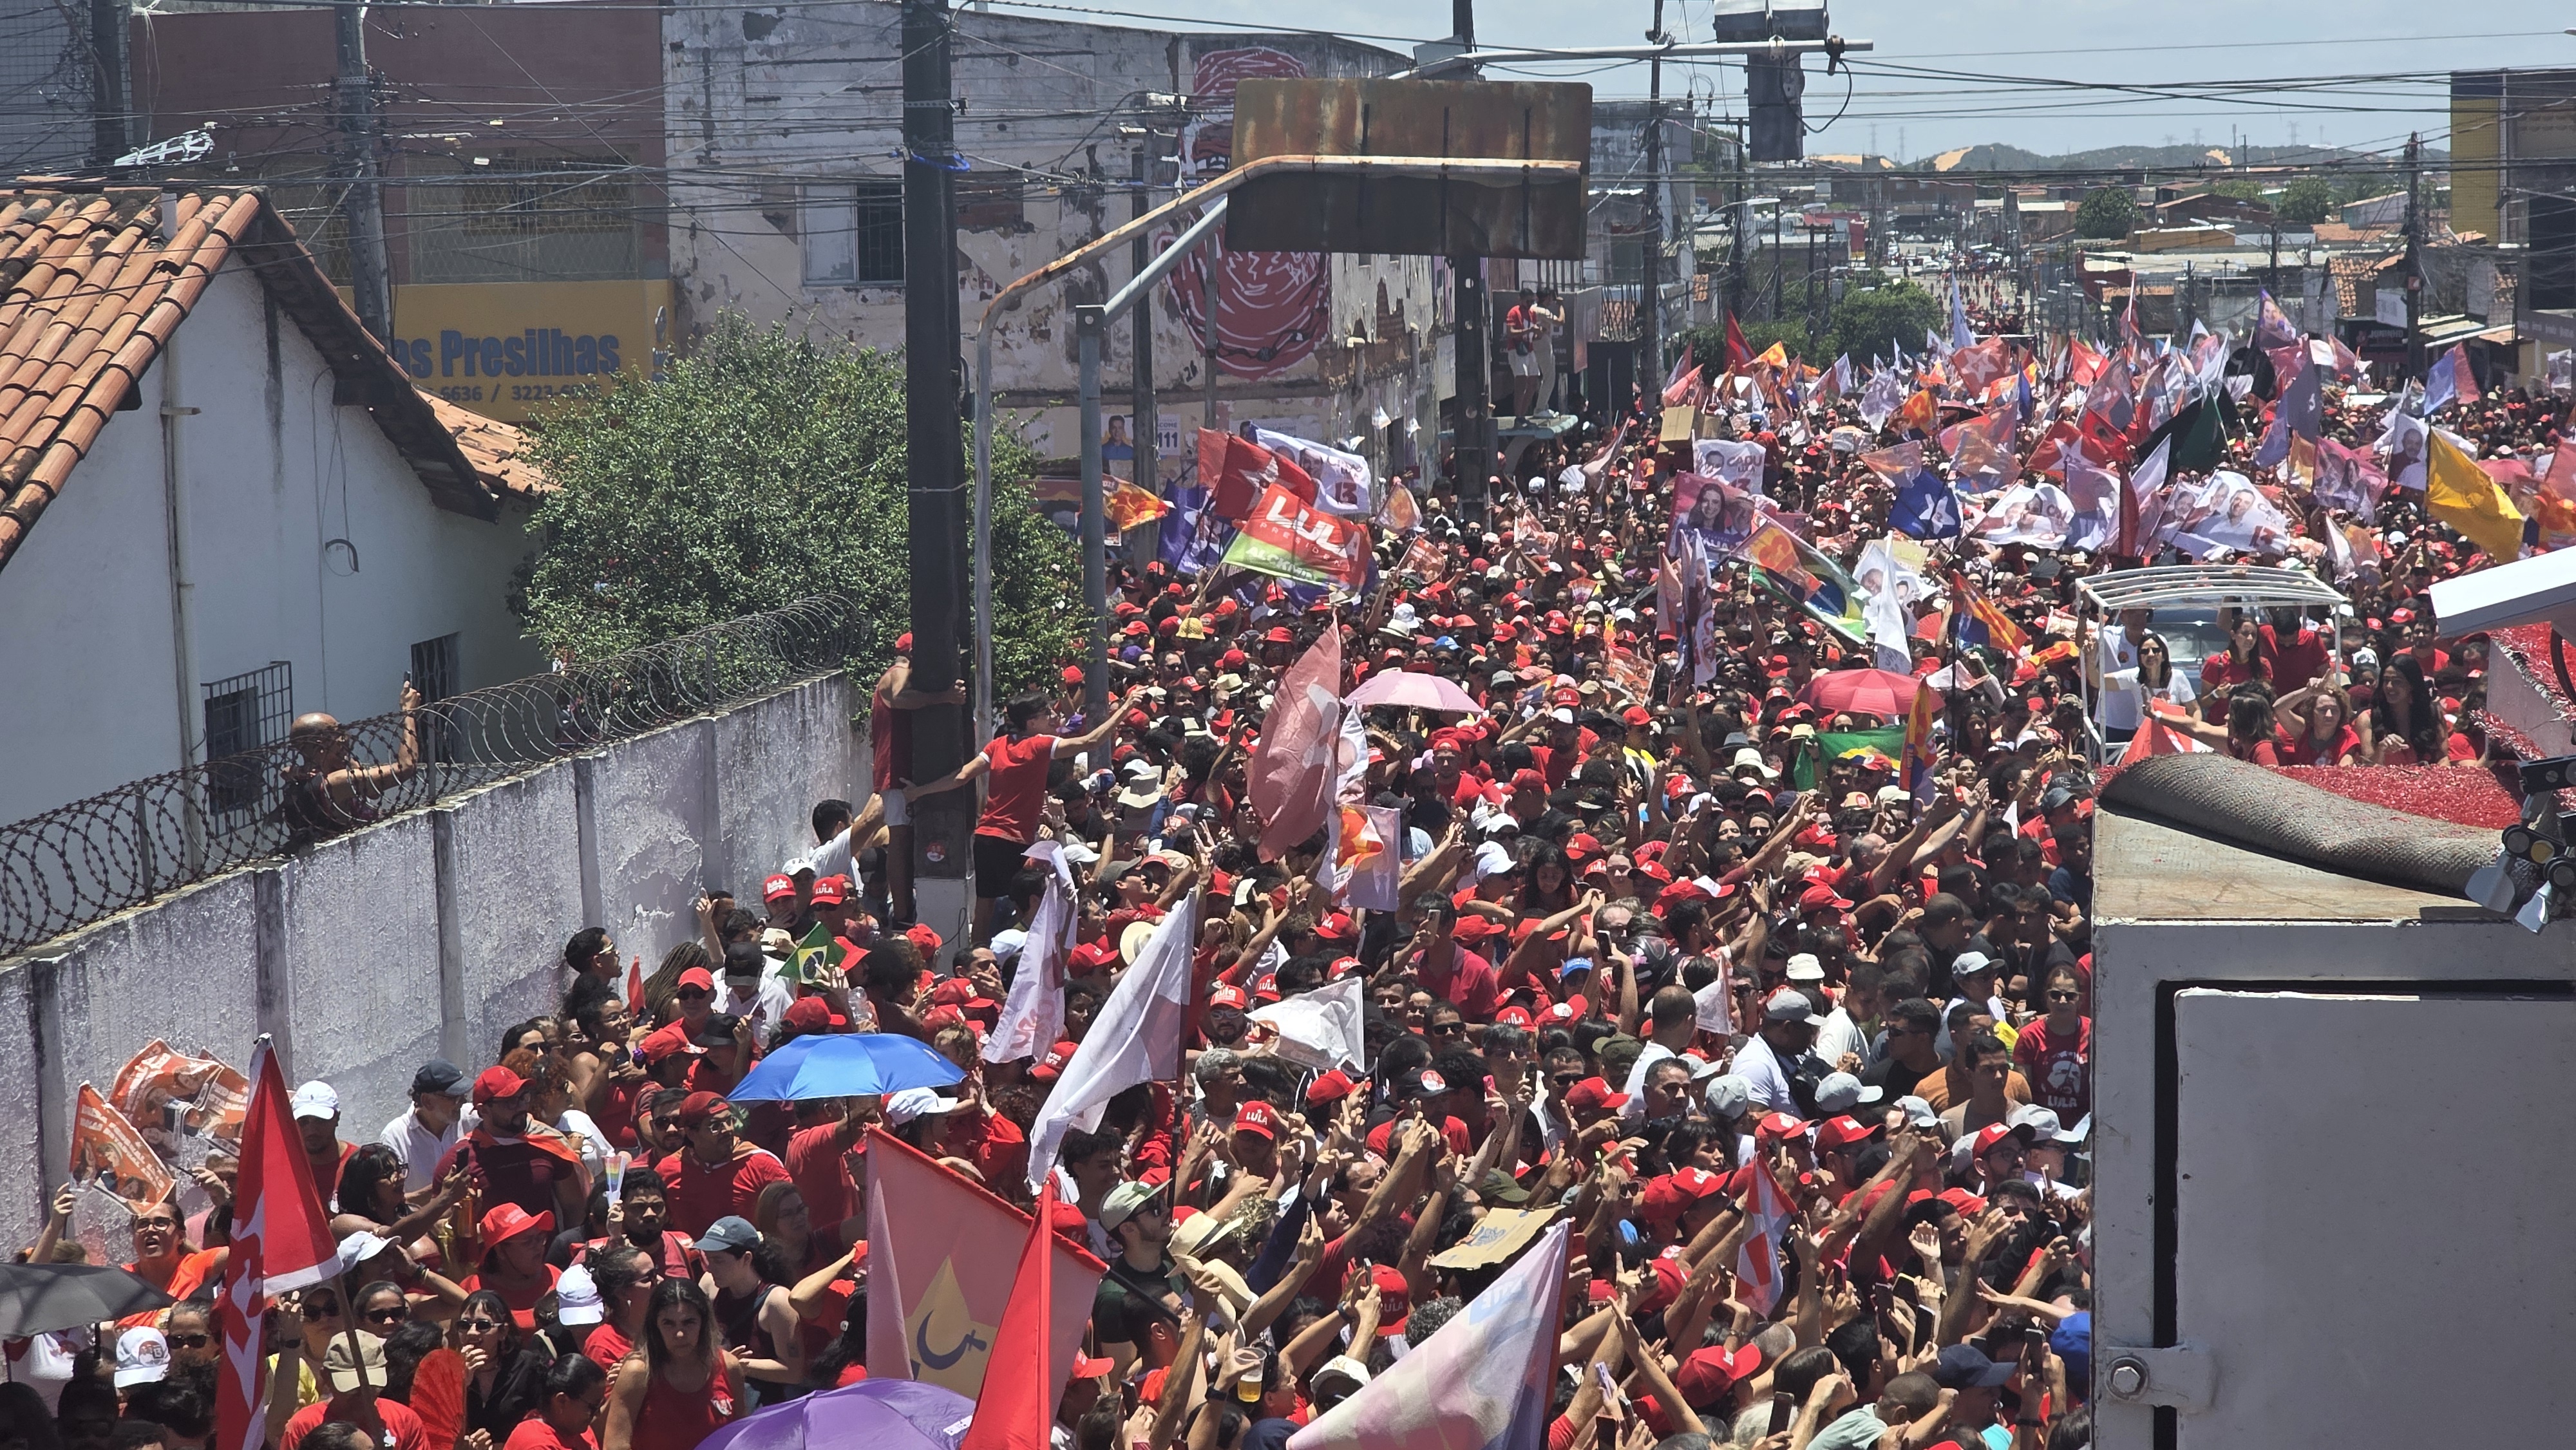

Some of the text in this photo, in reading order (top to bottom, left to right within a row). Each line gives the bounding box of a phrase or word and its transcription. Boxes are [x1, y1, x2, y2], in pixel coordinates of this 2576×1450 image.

[440, 328, 620, 377] Presilhas
[815, 886, 833, 894] LULA
[1259, 981, 1277, 990] LULA
[2047, 1095, 2078, 1108] LULA
[1245, 1111, 1268, 1125] LULA
[1384, 1301, 1403, 1313] ULA
